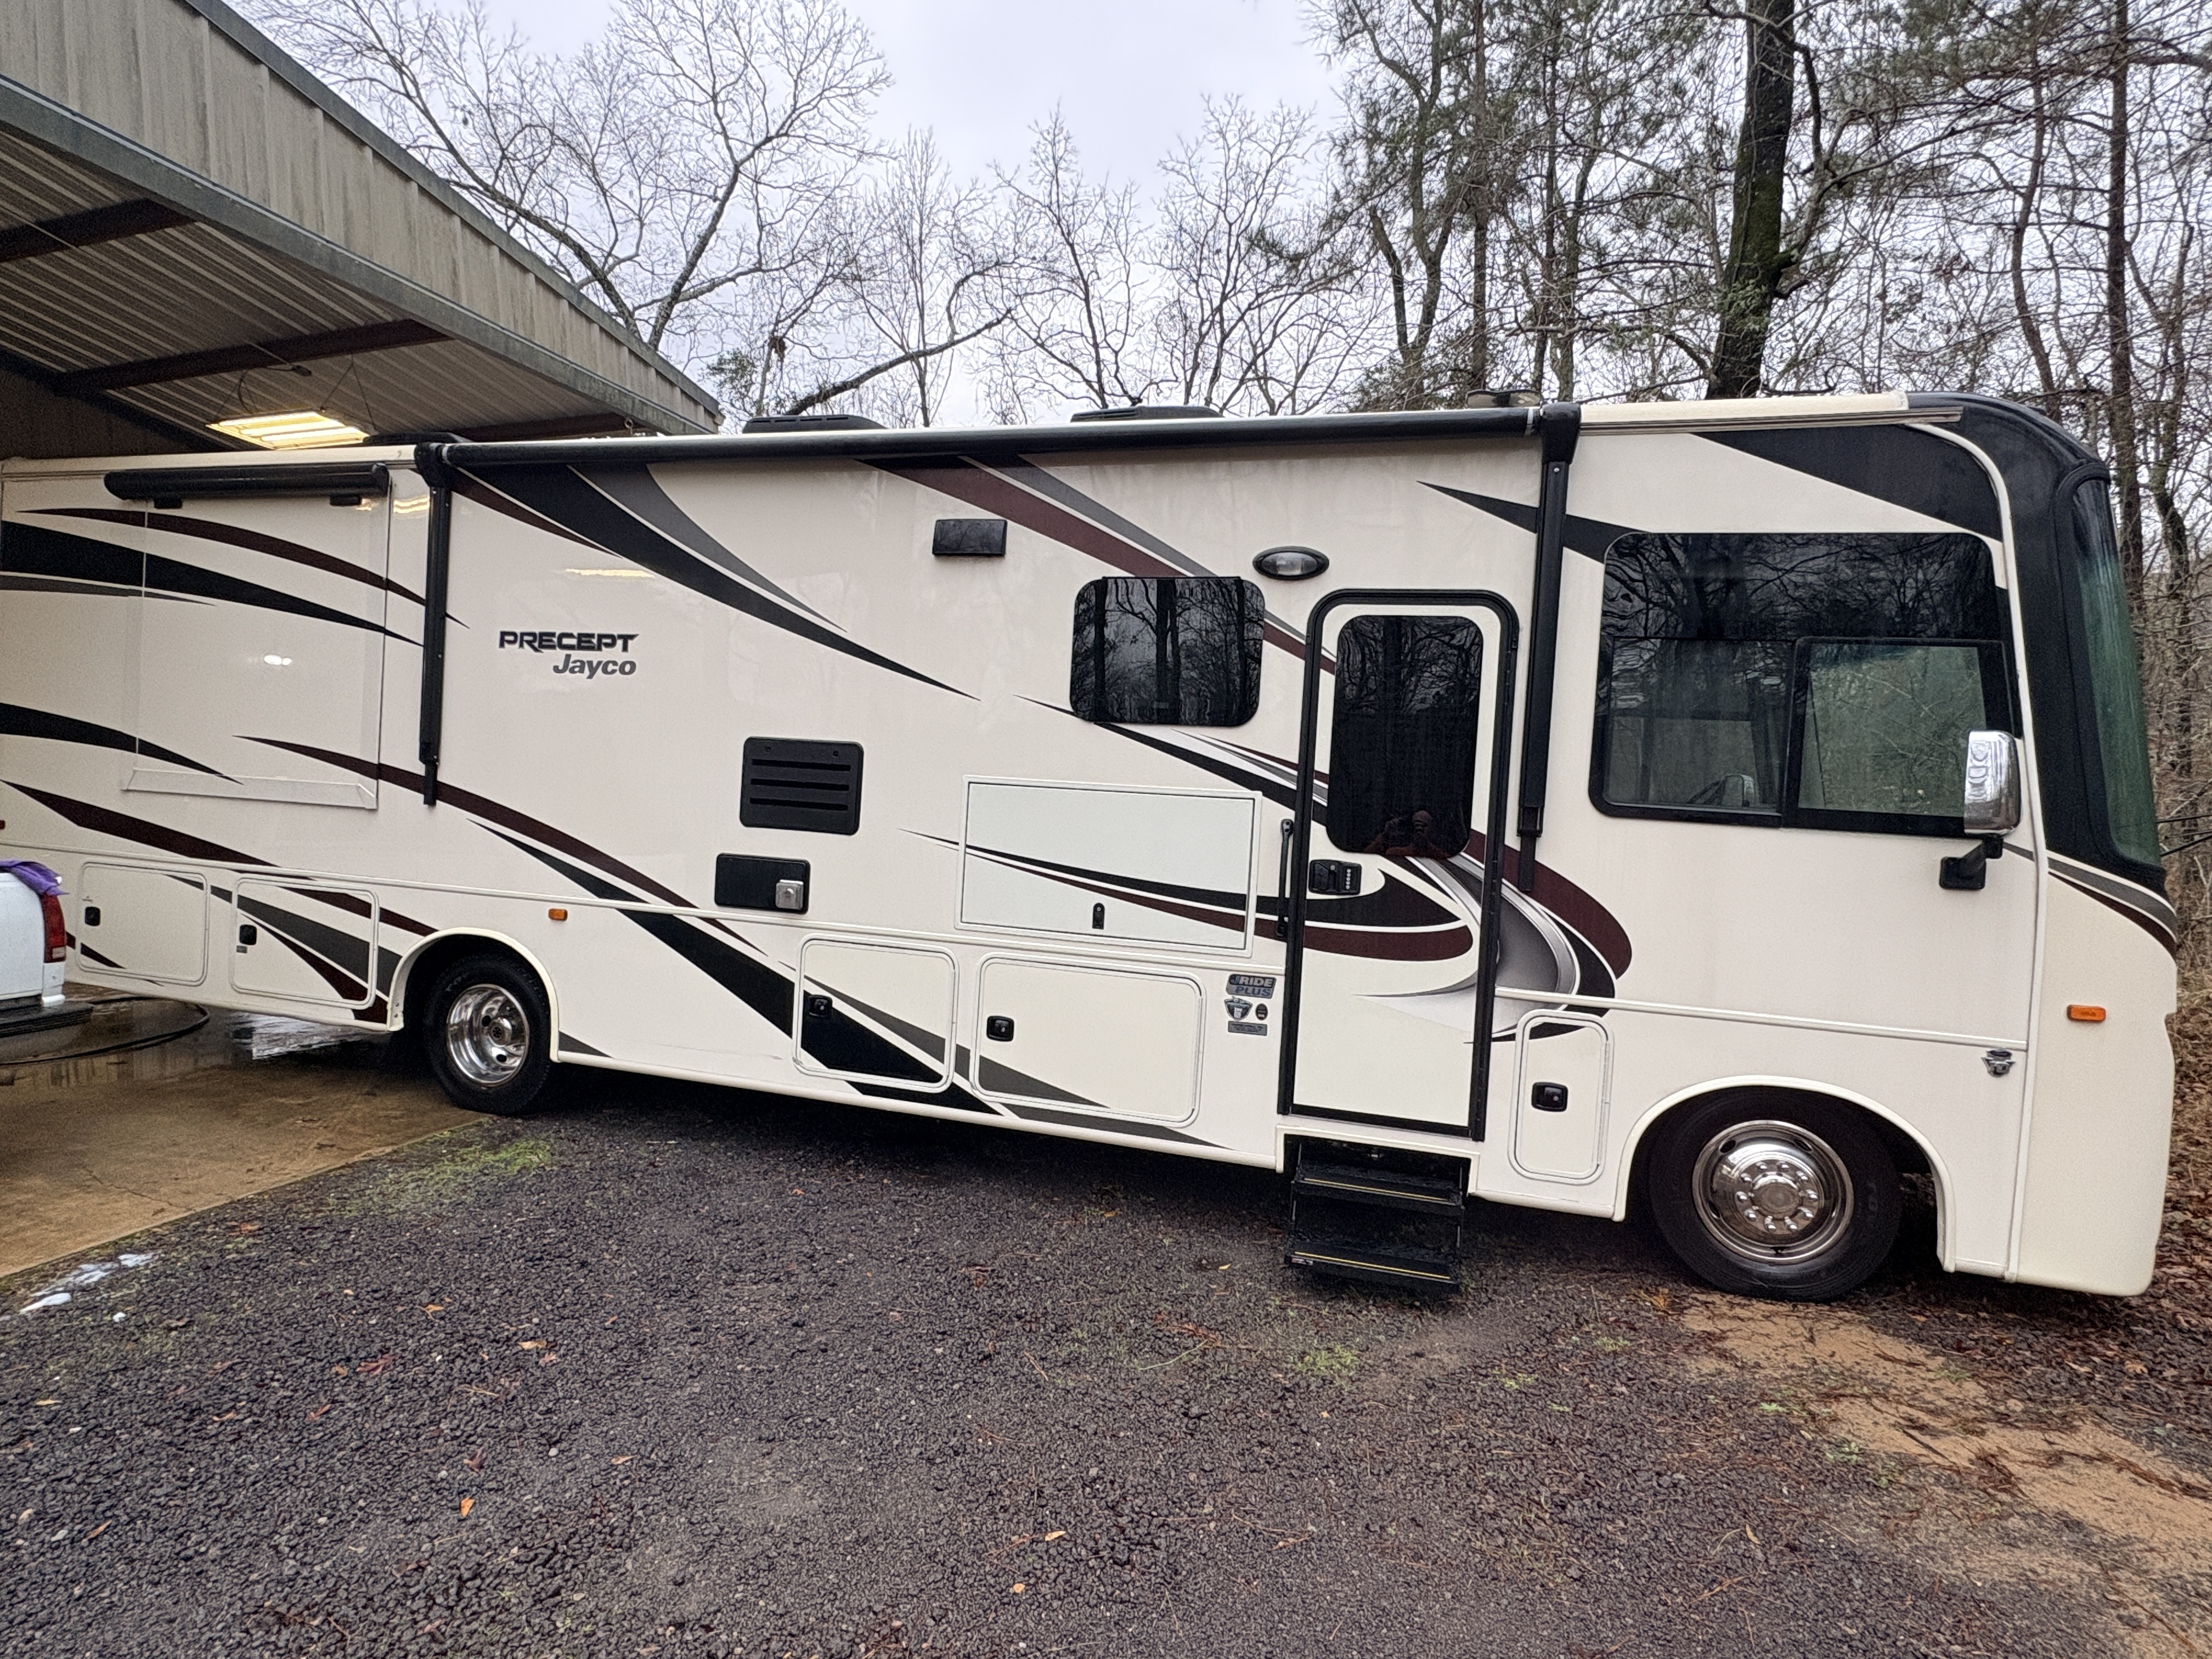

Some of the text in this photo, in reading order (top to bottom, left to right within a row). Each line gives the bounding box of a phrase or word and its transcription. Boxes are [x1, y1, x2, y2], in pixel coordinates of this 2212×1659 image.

[499, 631, 640, 653] PRECEPT
[553, 654, 636, 679] Jayco
[1235, 986, 1272, 996] PLUS
